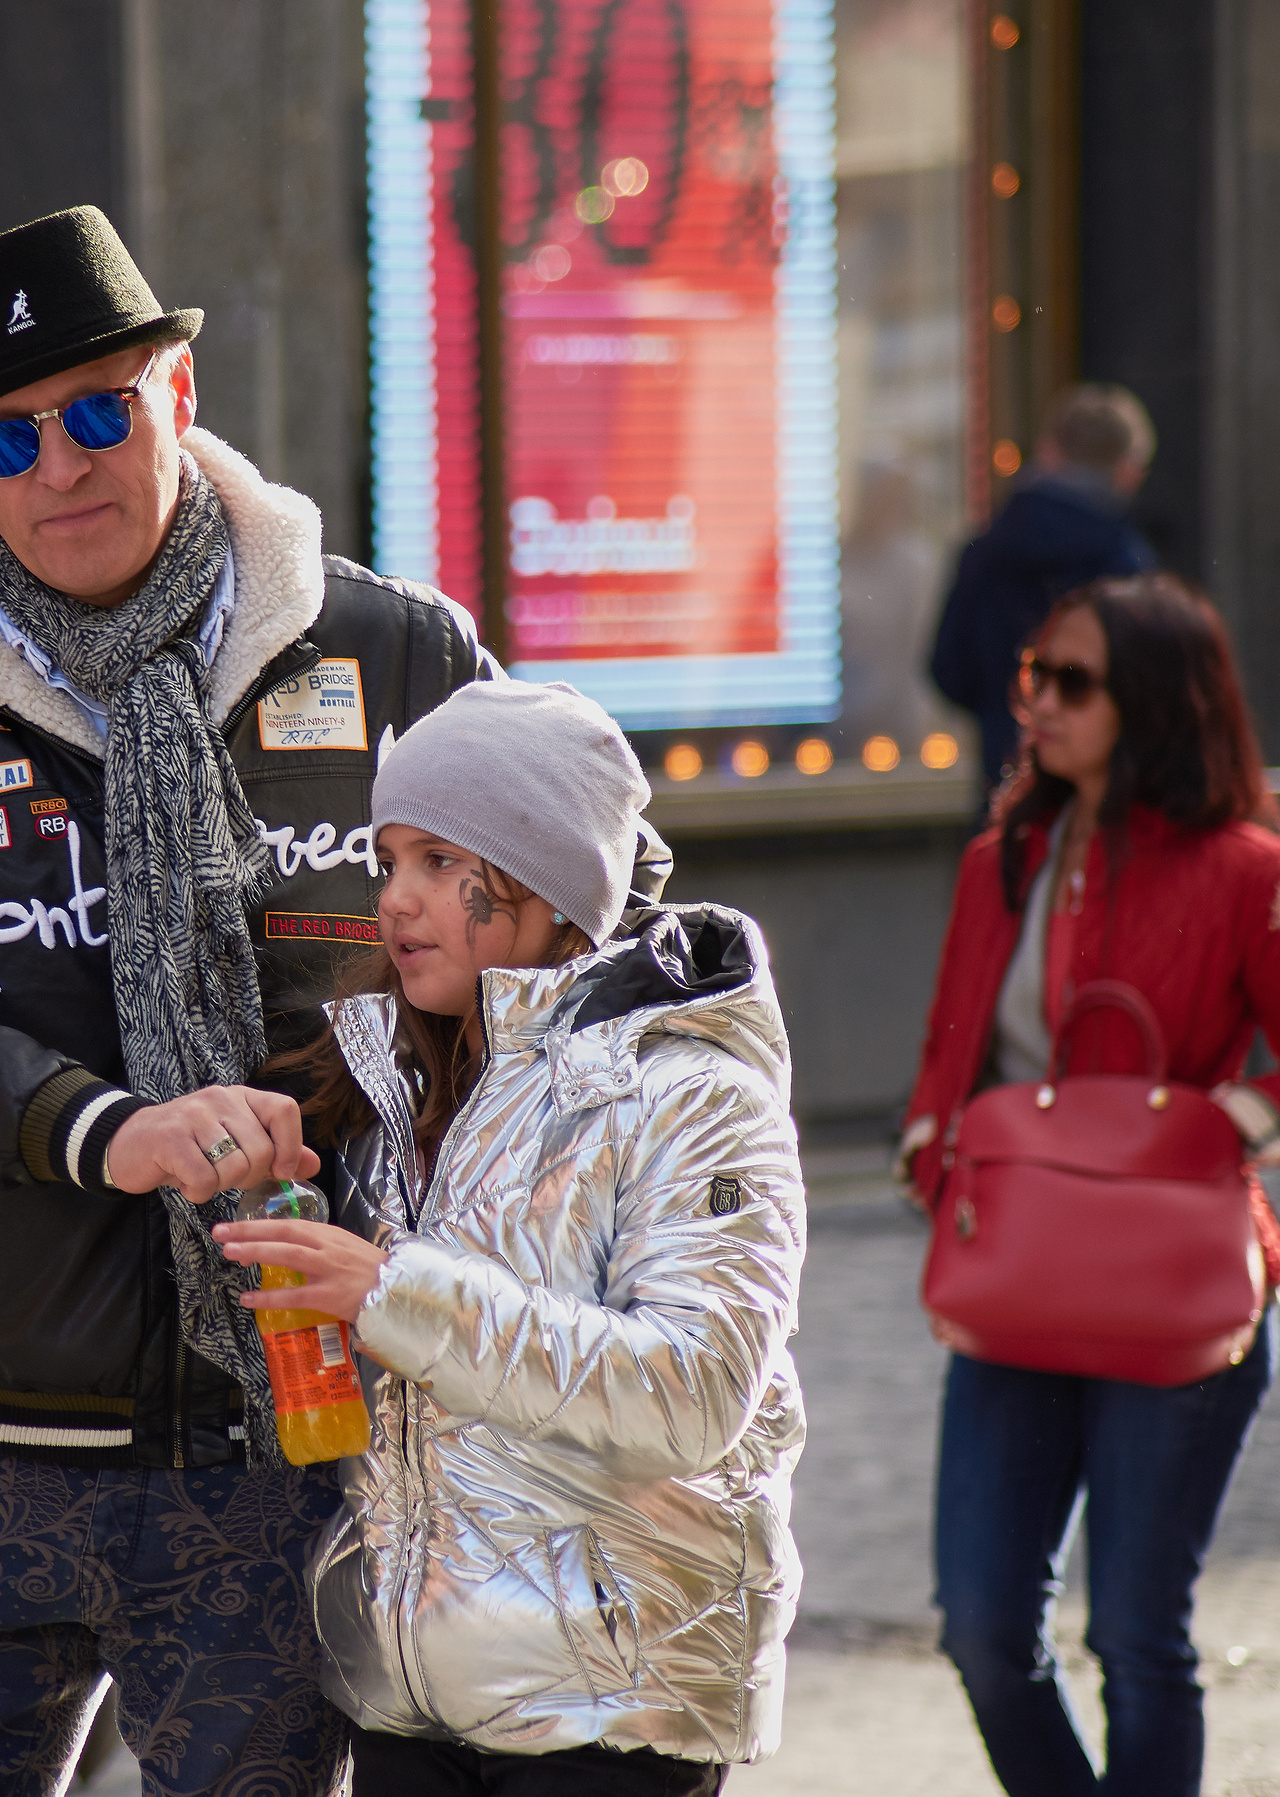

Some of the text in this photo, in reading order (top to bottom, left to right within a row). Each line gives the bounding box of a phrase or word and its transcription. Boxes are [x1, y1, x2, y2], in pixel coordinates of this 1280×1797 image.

[8, 319, 36, 334] KANGOL
[308, 674, 355, 690] BRIDGE
[320, 699, 356, 708] MONTREAL
[266, 717, 345, 729] NINETEEN NINETY-8
[39, 817, 66, 835] RB
[270, 918, 297, 934] THE
[302, 919, 330, 935] RED
